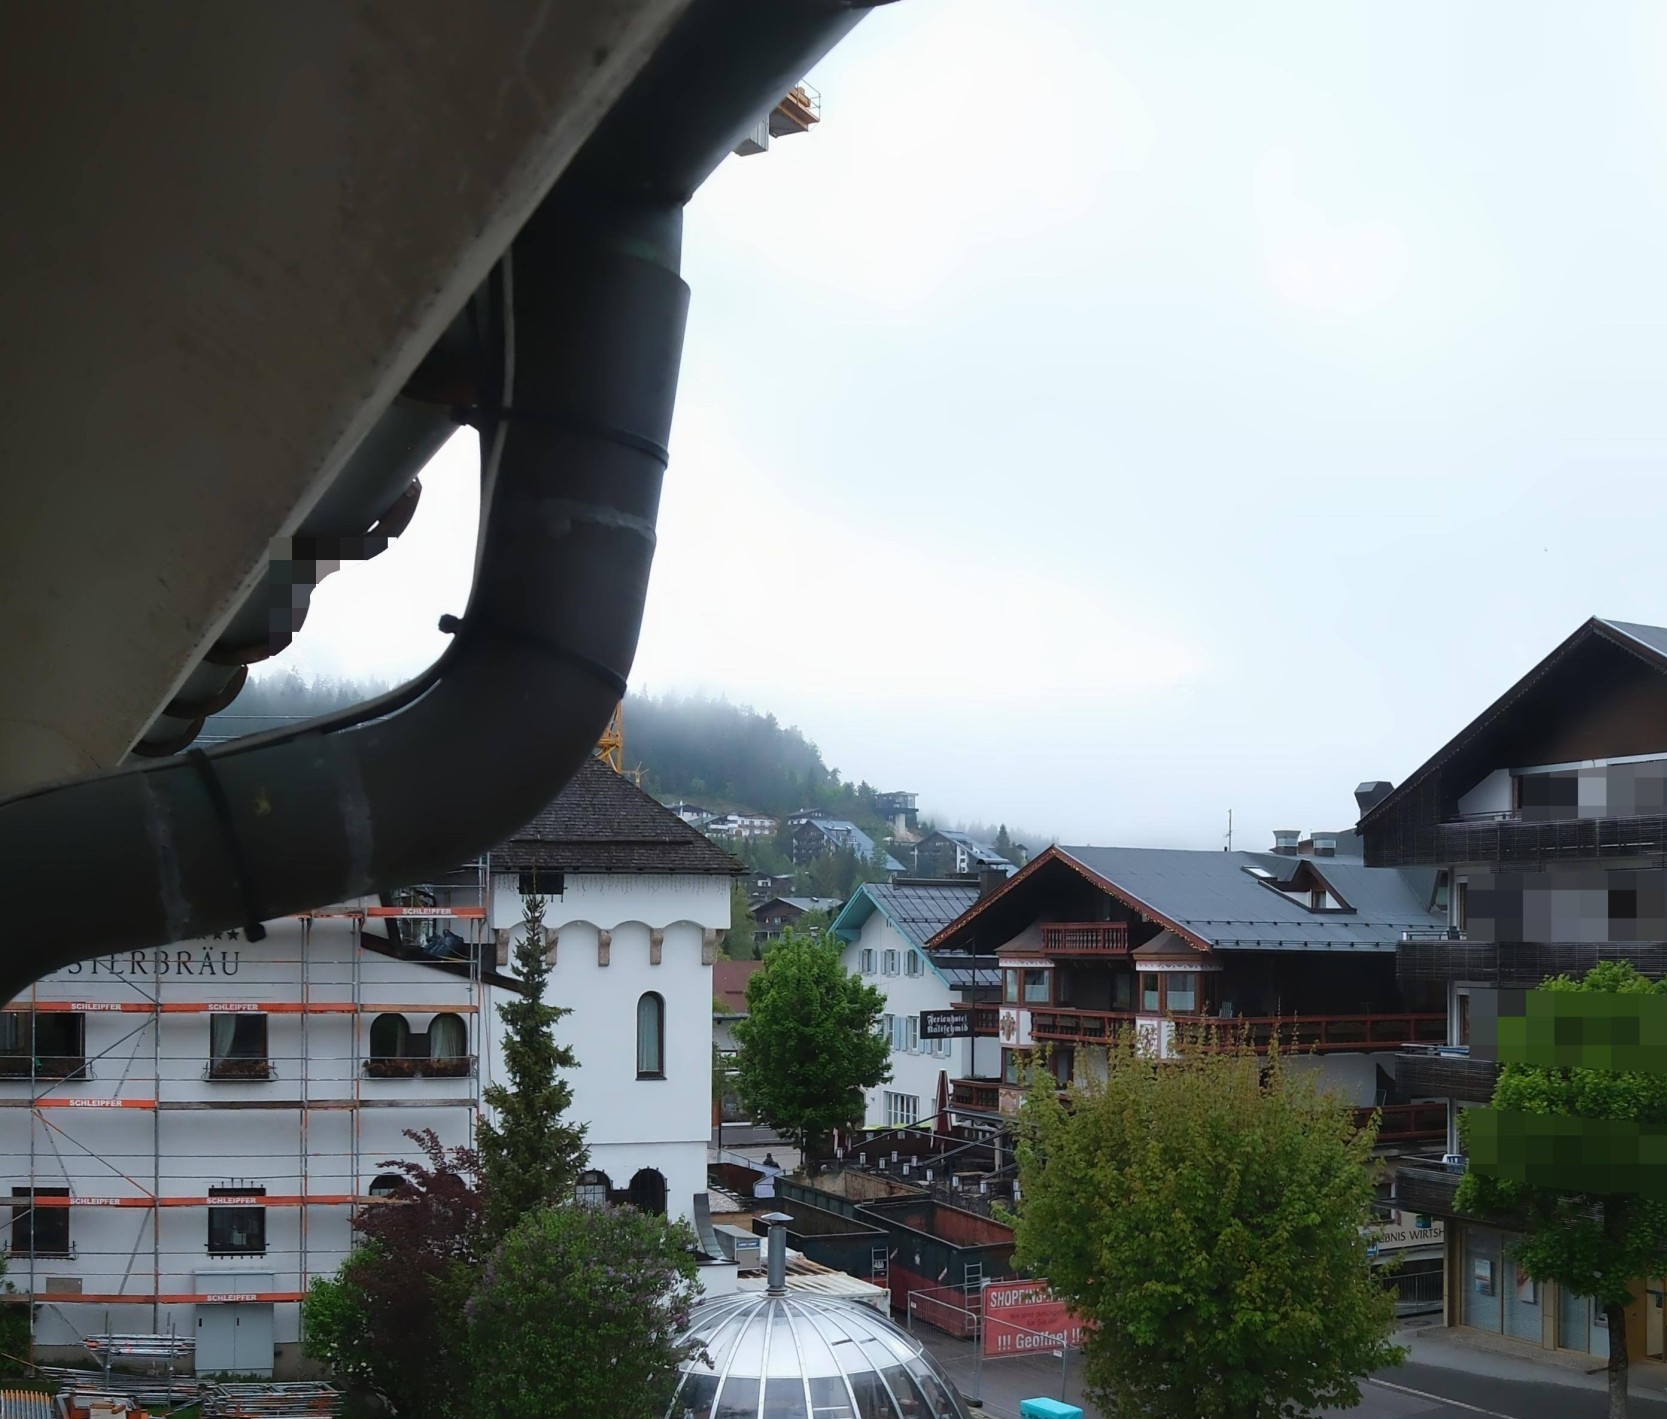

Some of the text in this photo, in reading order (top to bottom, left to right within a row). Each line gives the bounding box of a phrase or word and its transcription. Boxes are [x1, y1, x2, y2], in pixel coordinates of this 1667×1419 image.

[402, 907, 452, 915] SCHLEIPFER
[71, 1002, 122, 1011] SCHLEIPFER
[208, 1002, 259, 1011] SCHLEIPFER
[69, 1099, 122, 1107] SCHLEIPFER
[69, 1198, 121, 1206] SCHLEIPFER
[206, 1294, 257, 1302] SCHLEIPFER
